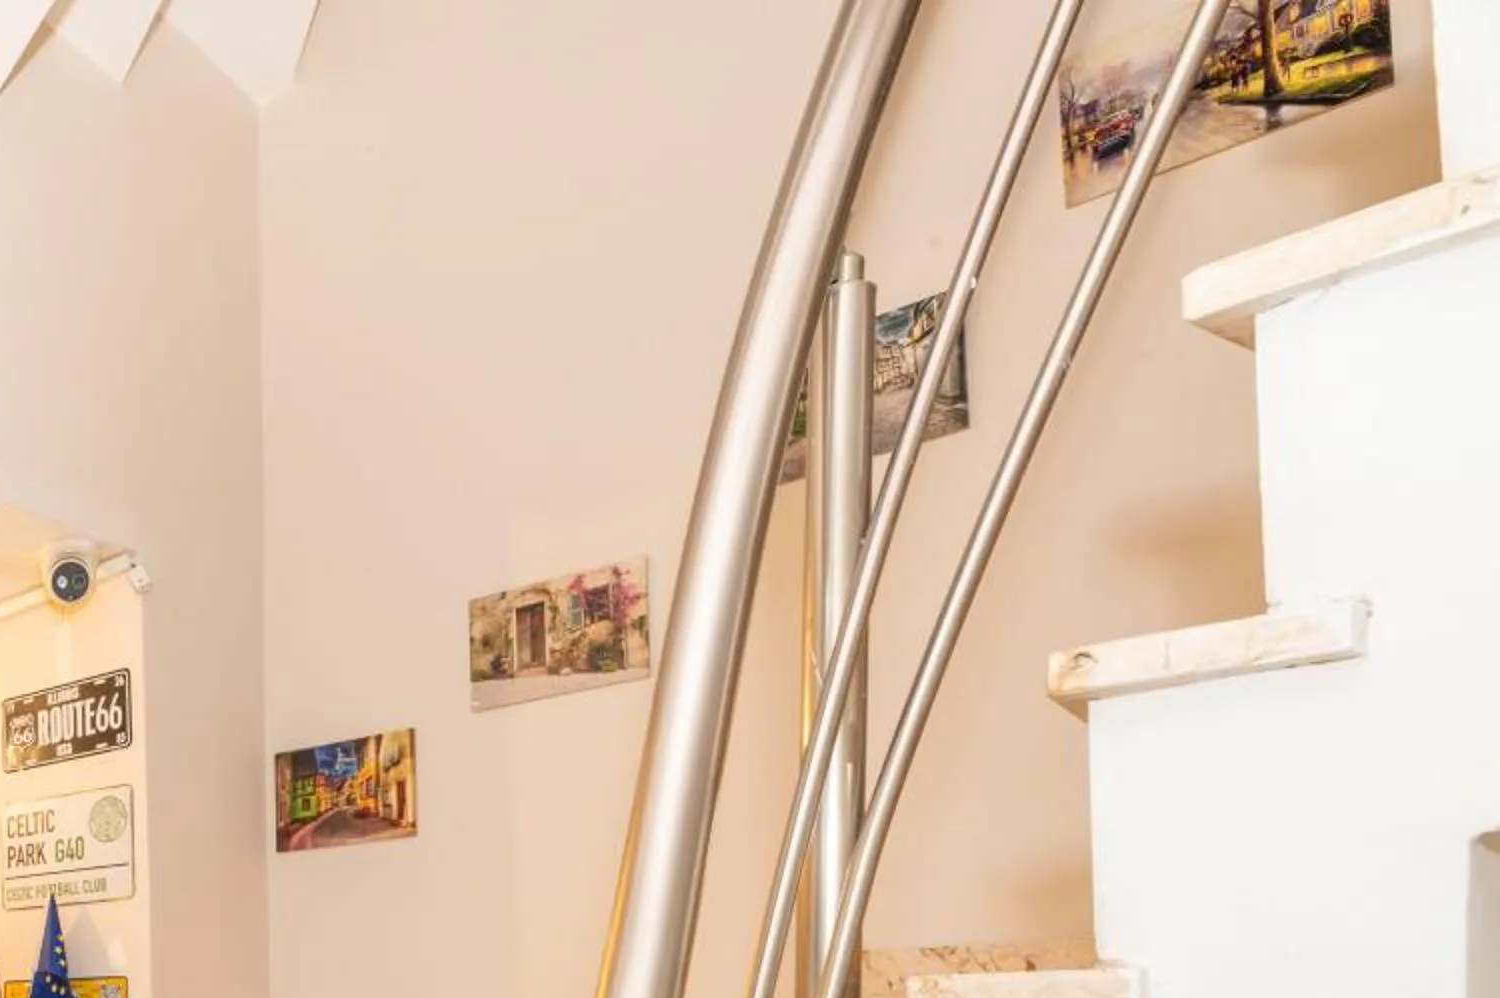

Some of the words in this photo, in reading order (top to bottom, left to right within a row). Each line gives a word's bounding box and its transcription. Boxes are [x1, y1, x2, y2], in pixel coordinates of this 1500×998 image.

[7, 809, 55, 839] CELTIC
[7, 842, 47, 869] PARK
[55, 836, 85, 863] G40
[82, 877, 107, 894] CLUB
